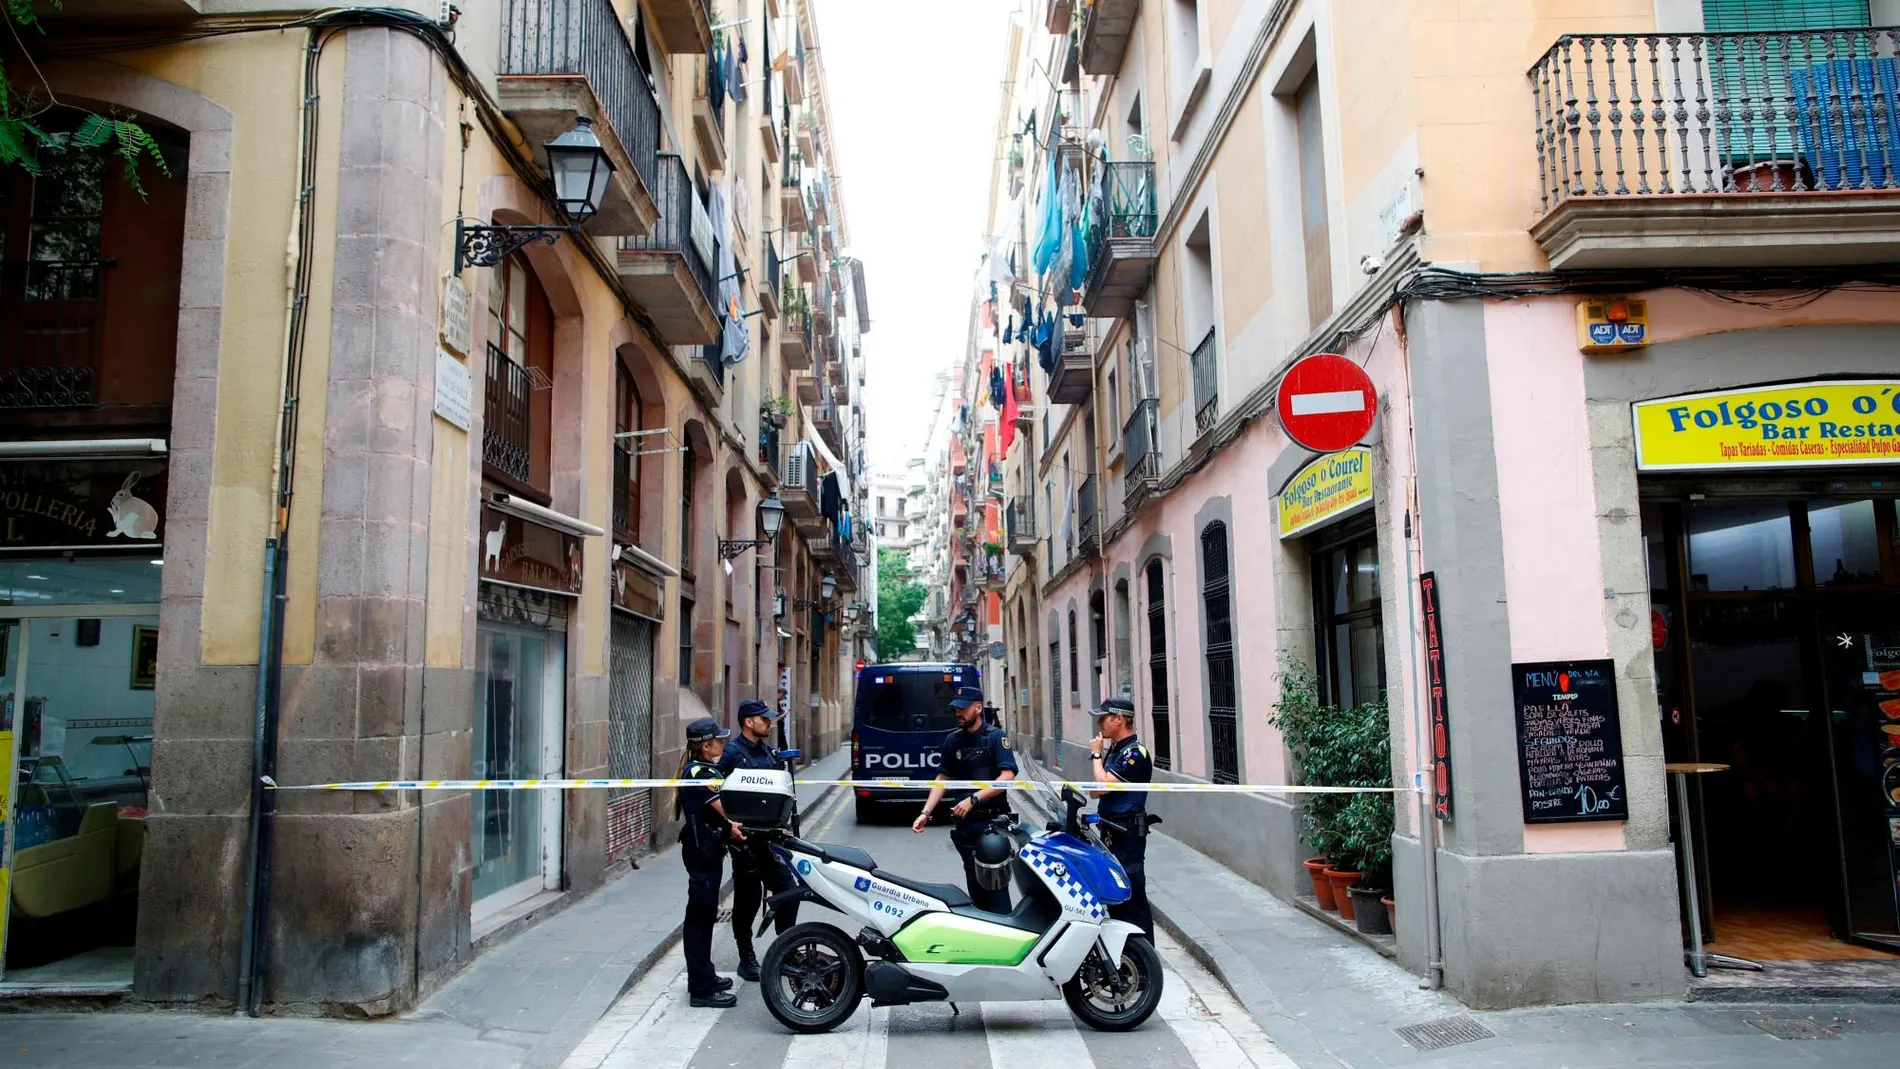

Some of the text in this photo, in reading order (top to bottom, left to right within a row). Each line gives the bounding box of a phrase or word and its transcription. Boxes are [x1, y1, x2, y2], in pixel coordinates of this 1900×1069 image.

[1594, 325, 1612, 335] ADT
[1622, 324, 1640, 334] ADT
[1667, 397, 1828, 432] Folgoso
[1761, 422, 1810, 440] Bar
[1720, 442, 1739, 460] Tapas
[1739, 441, 1767, 457] Variadas
[1771, 440, 1799, 456] Comidas
[1800, 440, 1825, 455] Caseras
[1830, 439, 1870, 457] Especialidad
[1871, 438, 1891, 456] Pulpo
[1283, 473, 1317, 510] Folgoso
[1422, 578, 1447, 797] TATTOO
[1523, 704, 1569, 713] PAELLA
[1524, 736, 1577, 746] SEGUNDOS
[1579, 739, 1603, 747] POLLO
[865, 752, 942, 768] POLIC
[1576, 774, 1611, 782] PATATAS
[1532, 799, 1562, 810] POSTRE
[902, 892, 930, 908] Urbana
[885, 905, 904, 918] 092
